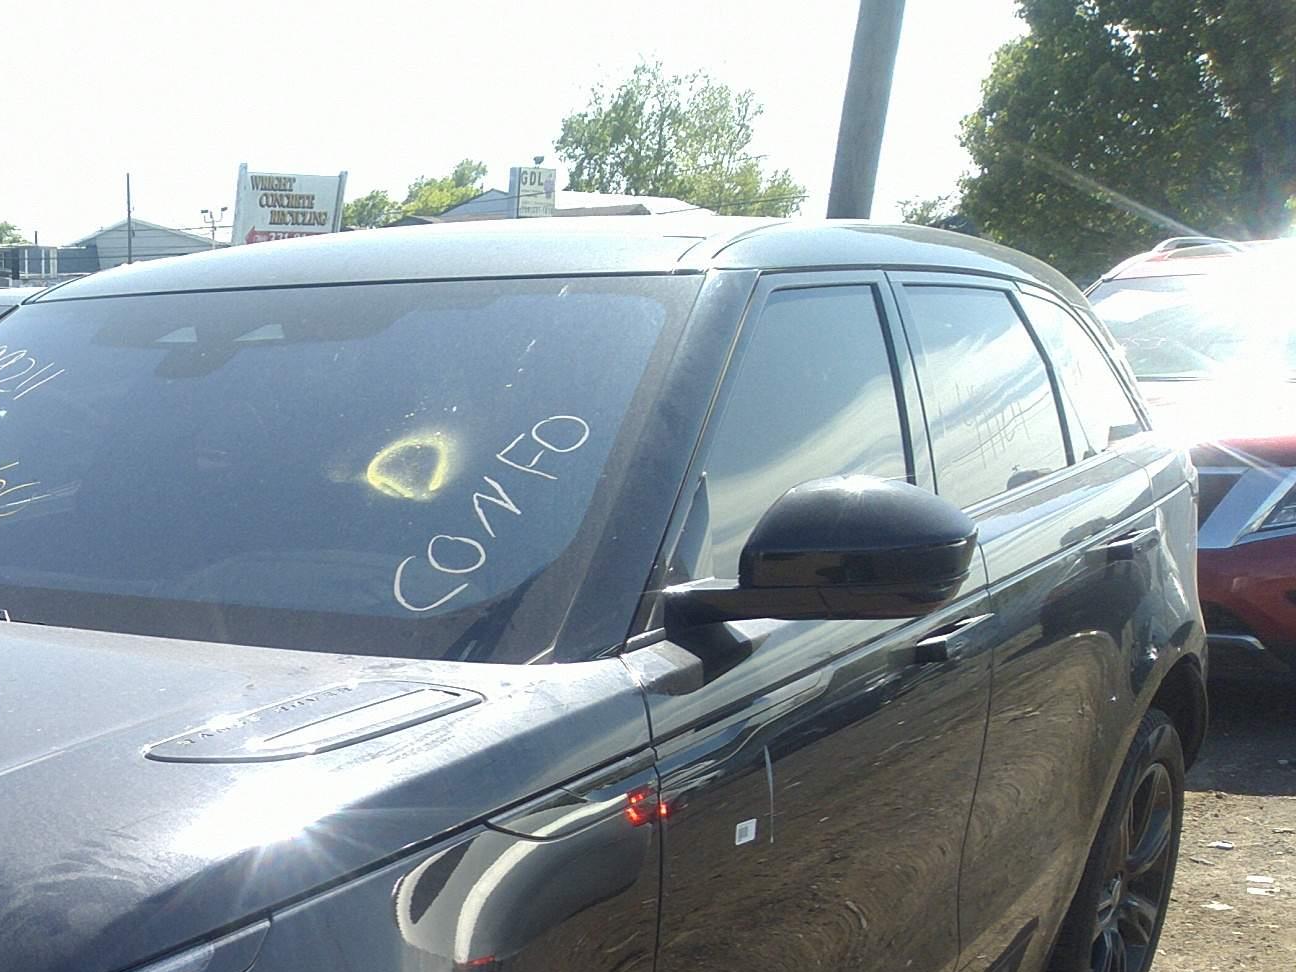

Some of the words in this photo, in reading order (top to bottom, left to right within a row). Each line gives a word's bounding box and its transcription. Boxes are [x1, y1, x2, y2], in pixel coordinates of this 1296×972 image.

[250, 175, 296, 192] WRIGHT
[258, 192, 315, 209] CONCRETE
[268, 209, 328, 226] RECYCLING
